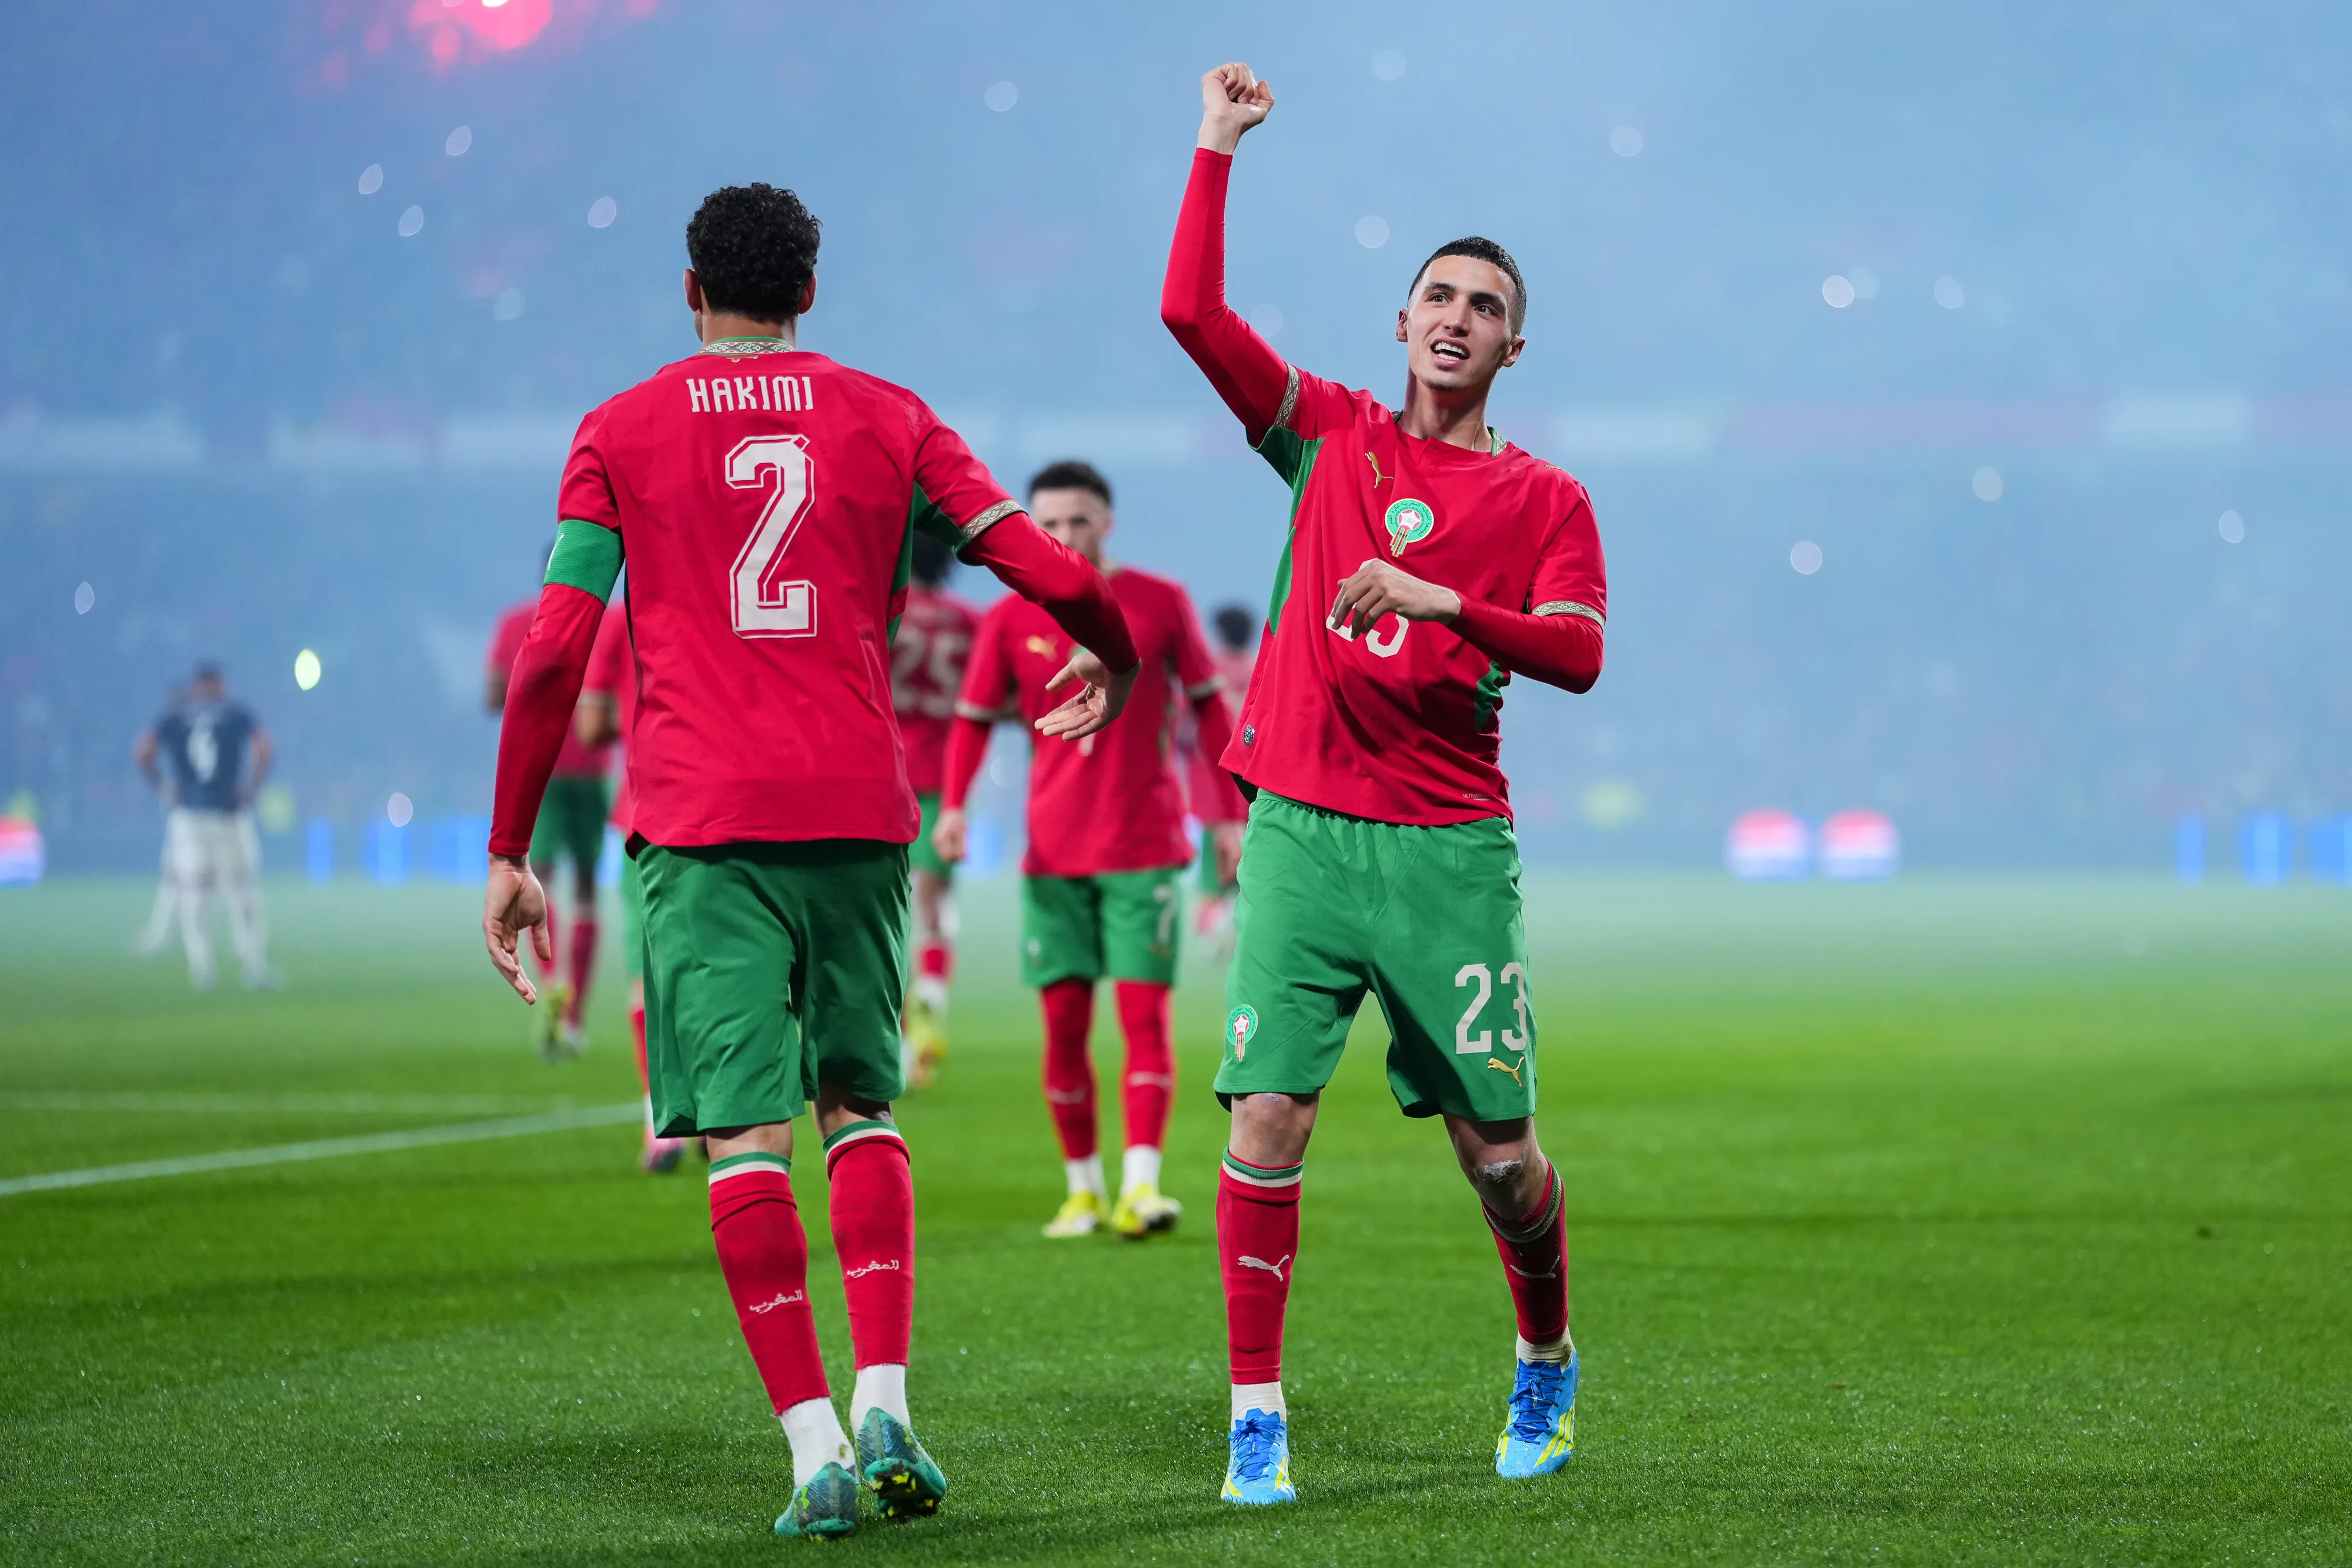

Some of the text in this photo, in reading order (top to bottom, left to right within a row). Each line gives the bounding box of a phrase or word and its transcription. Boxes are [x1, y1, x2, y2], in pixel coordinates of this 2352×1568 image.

[686, 376, 813, 413] HAKIMI
[725, 434, 817, 639] 2
[1455, 962, 1528, 1054] 23
[847, 1259, 900, 1279] المغرب
[749, 1289, 803, 1315] المغرب
